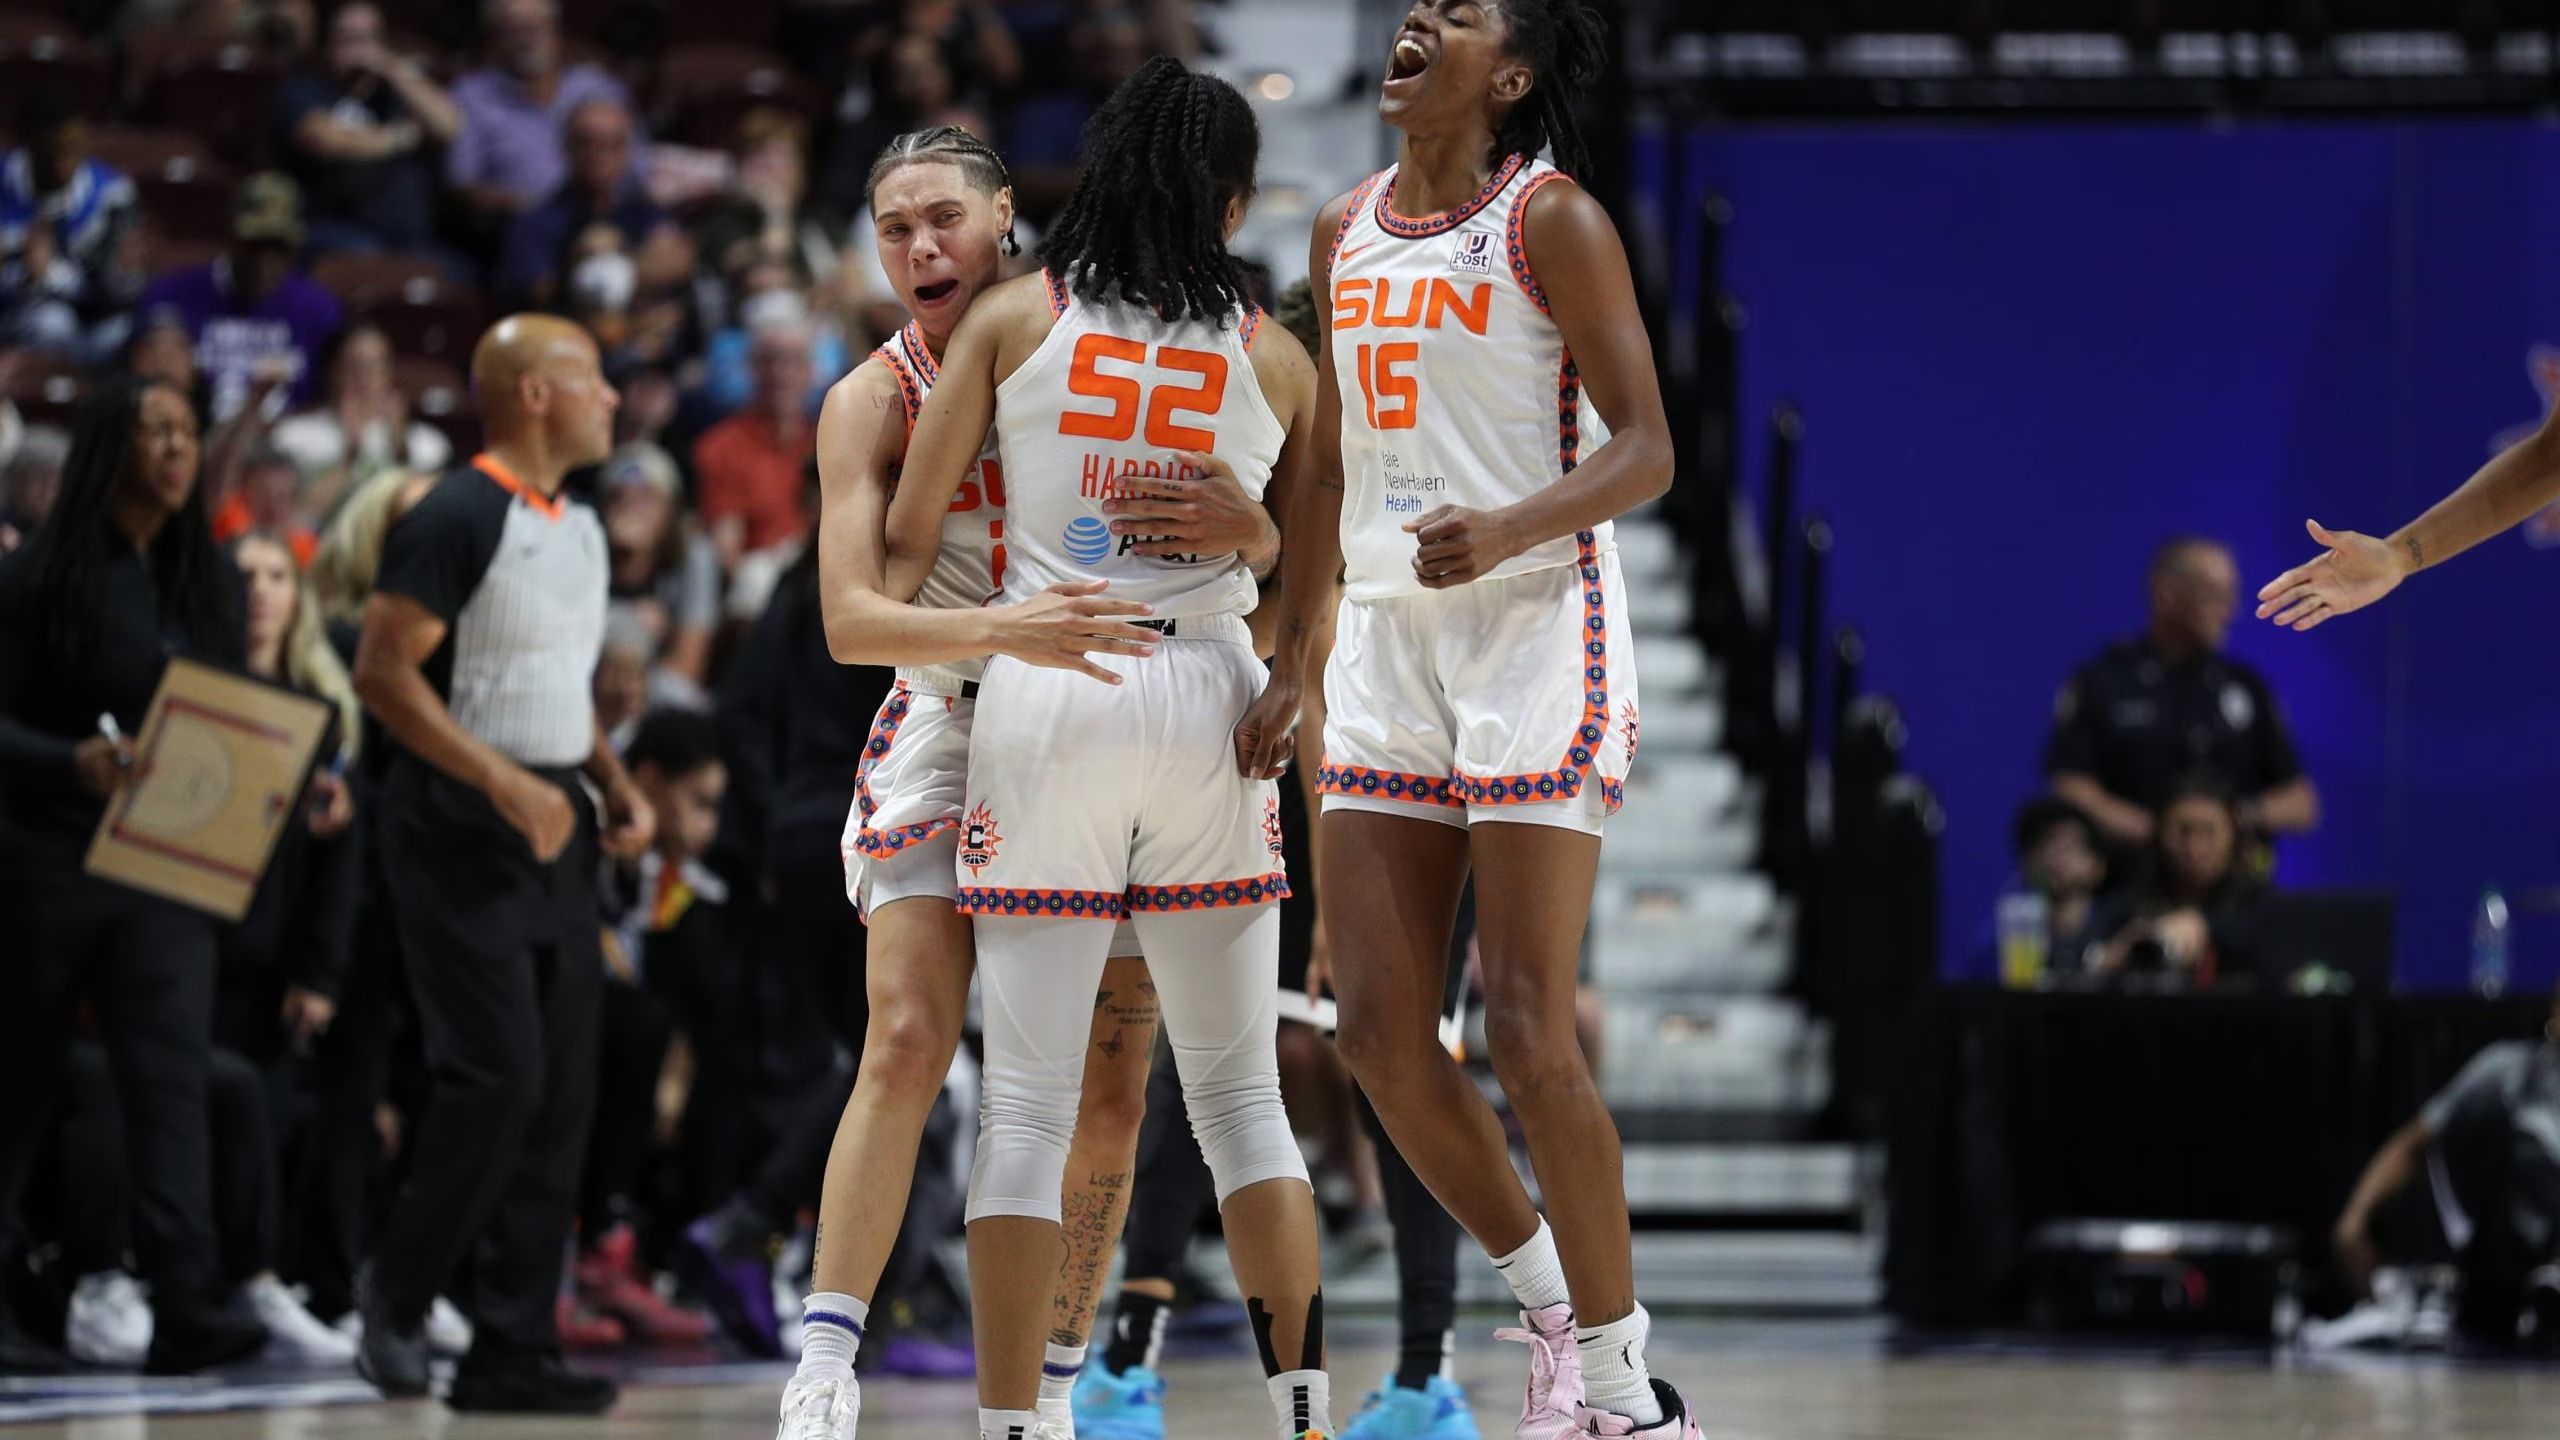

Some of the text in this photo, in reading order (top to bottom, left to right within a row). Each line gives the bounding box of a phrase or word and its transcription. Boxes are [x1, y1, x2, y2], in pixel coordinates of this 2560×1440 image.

[1453, 251, 1488, 267] Post
[1333, 277, 1493, 335] SUN
[1058, 333, 1229, 454] 52
[1357, 342, 1419, 429] 15
[1384, 471, 1445, 491] NewHaven
[1385, 493, 1422, 513] Health
